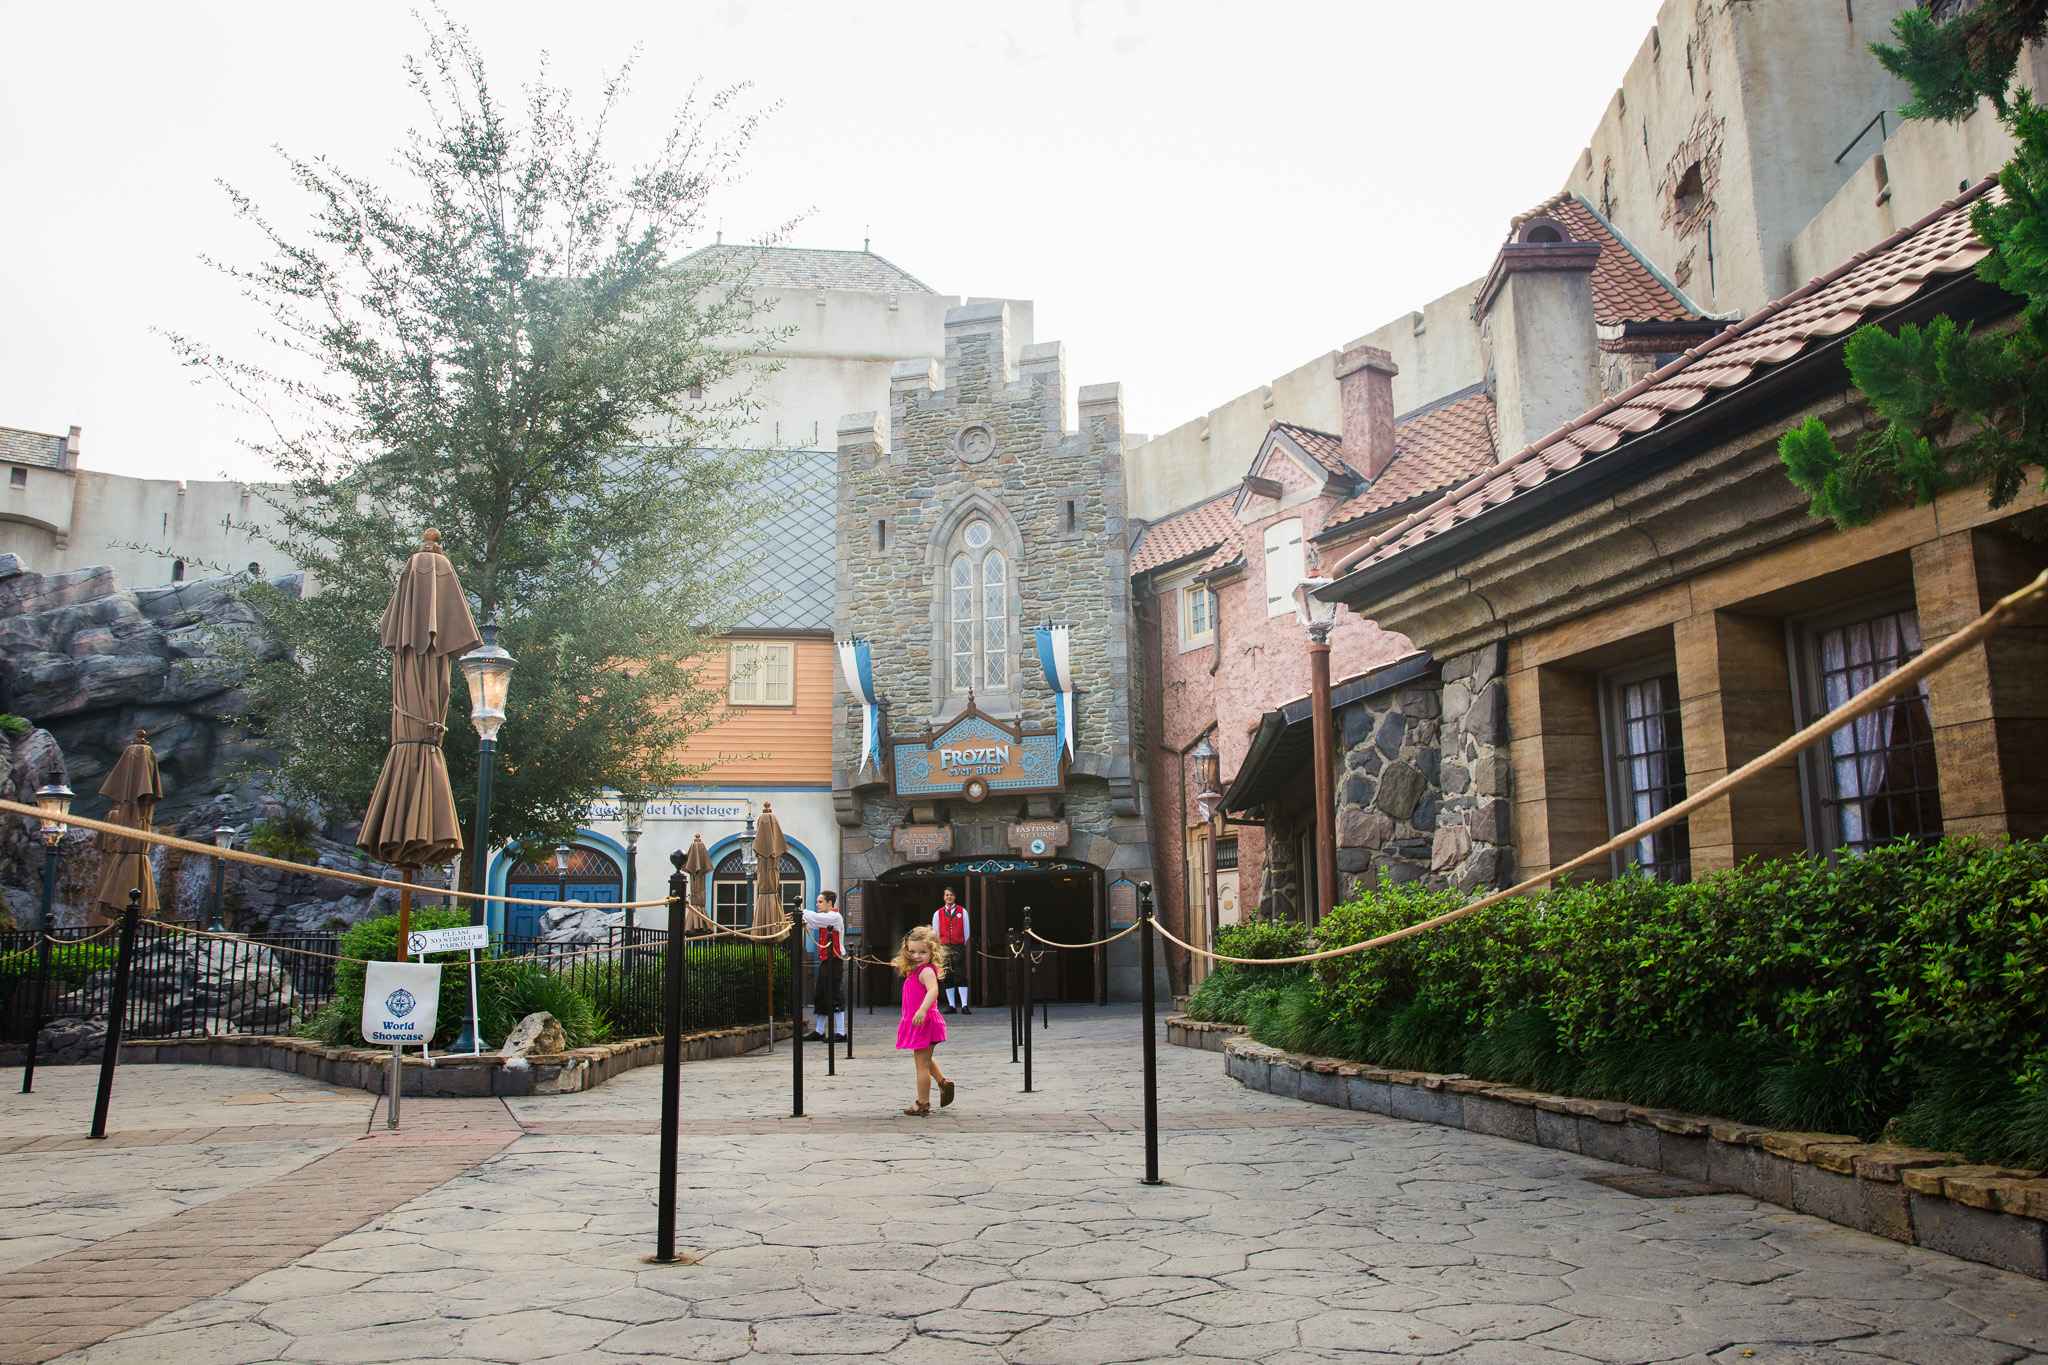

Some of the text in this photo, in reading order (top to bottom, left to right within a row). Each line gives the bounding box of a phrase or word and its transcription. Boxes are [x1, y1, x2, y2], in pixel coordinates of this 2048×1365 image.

[940, 745, 1010, 770] FROZEN
[948, 765, 1004, 776] ever after
[646, 804, 740, 817] det Kjølelager
[1020, 831, 1055, 839] RETURN
[442, 929, 471, 937] PLEASE
[443, 934, 483, 943] STROLLER
[440, 941, 474, 949] PARKING
[383, 1021, 415, 1030] World
[372, 1031, 424, 1041] Showcase
